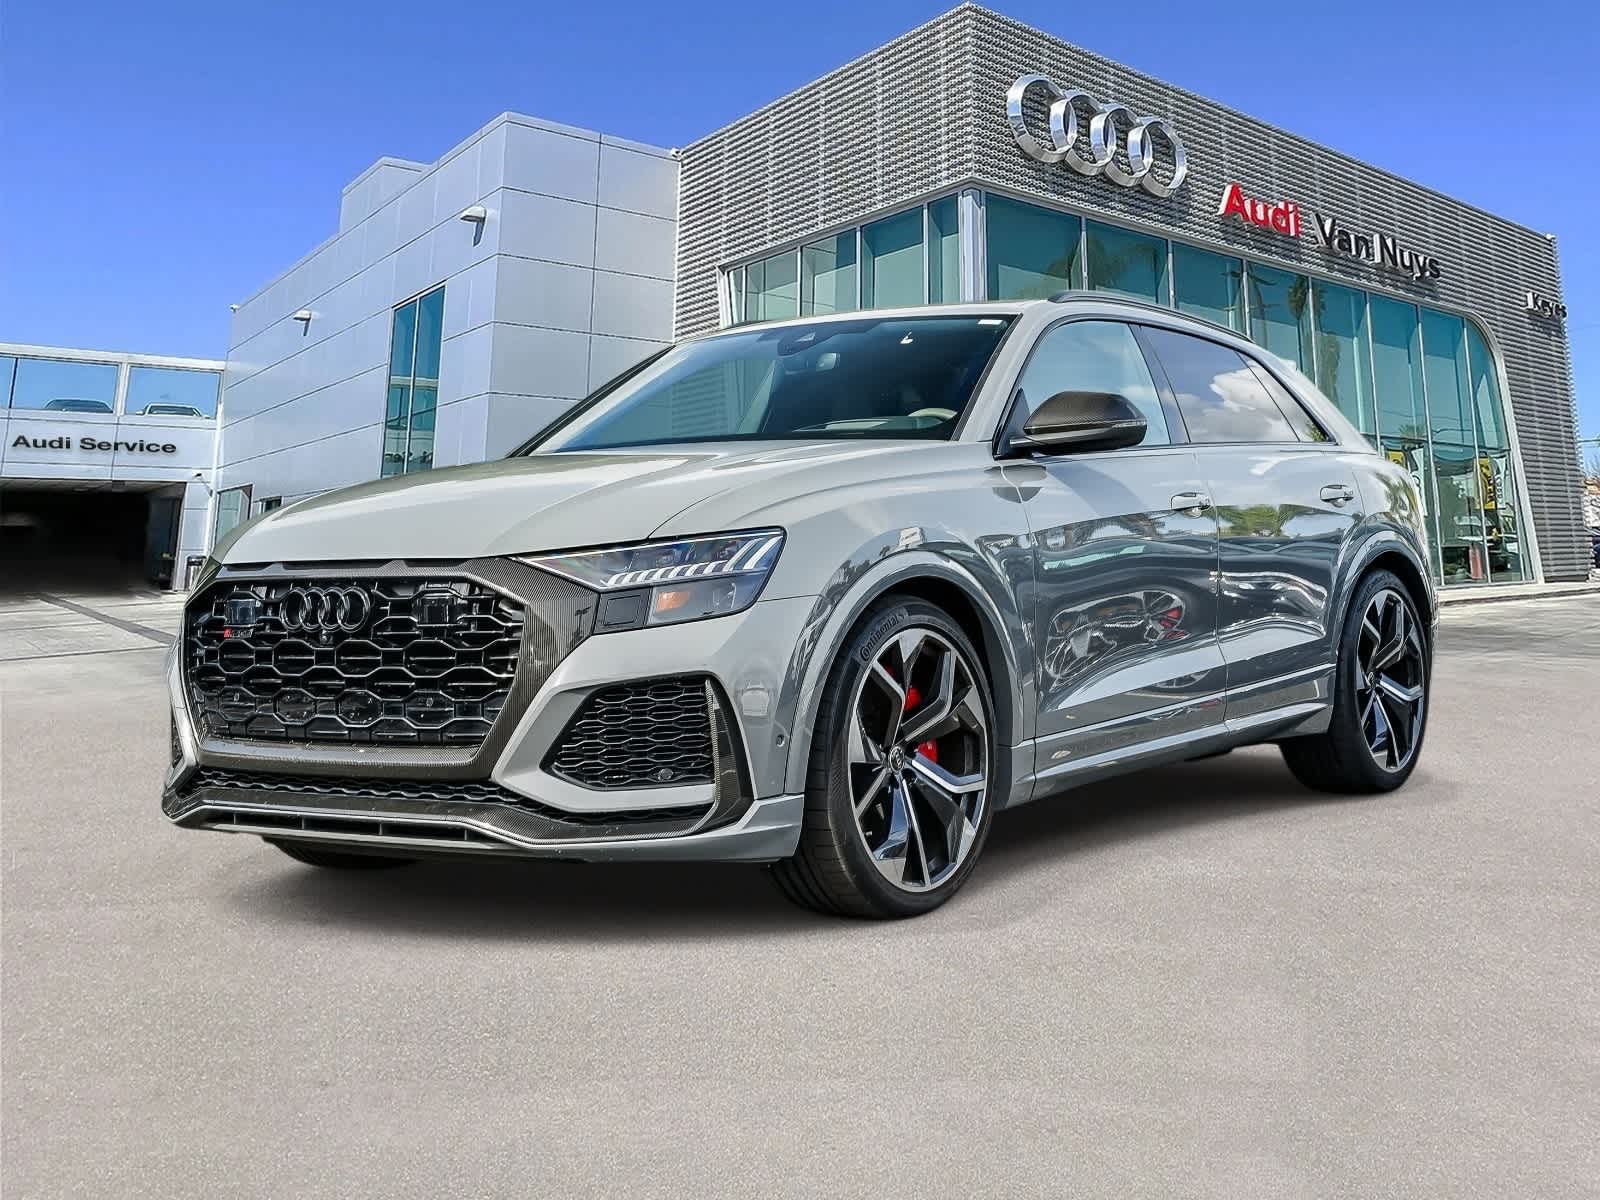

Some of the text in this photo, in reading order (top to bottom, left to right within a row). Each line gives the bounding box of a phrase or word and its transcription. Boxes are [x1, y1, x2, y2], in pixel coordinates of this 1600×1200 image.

[1218, 183, 1441, 280] Audi Van Nuys
[12, 435, 177, 454] Audi Service
[860, 614, 900, 661] Continental
